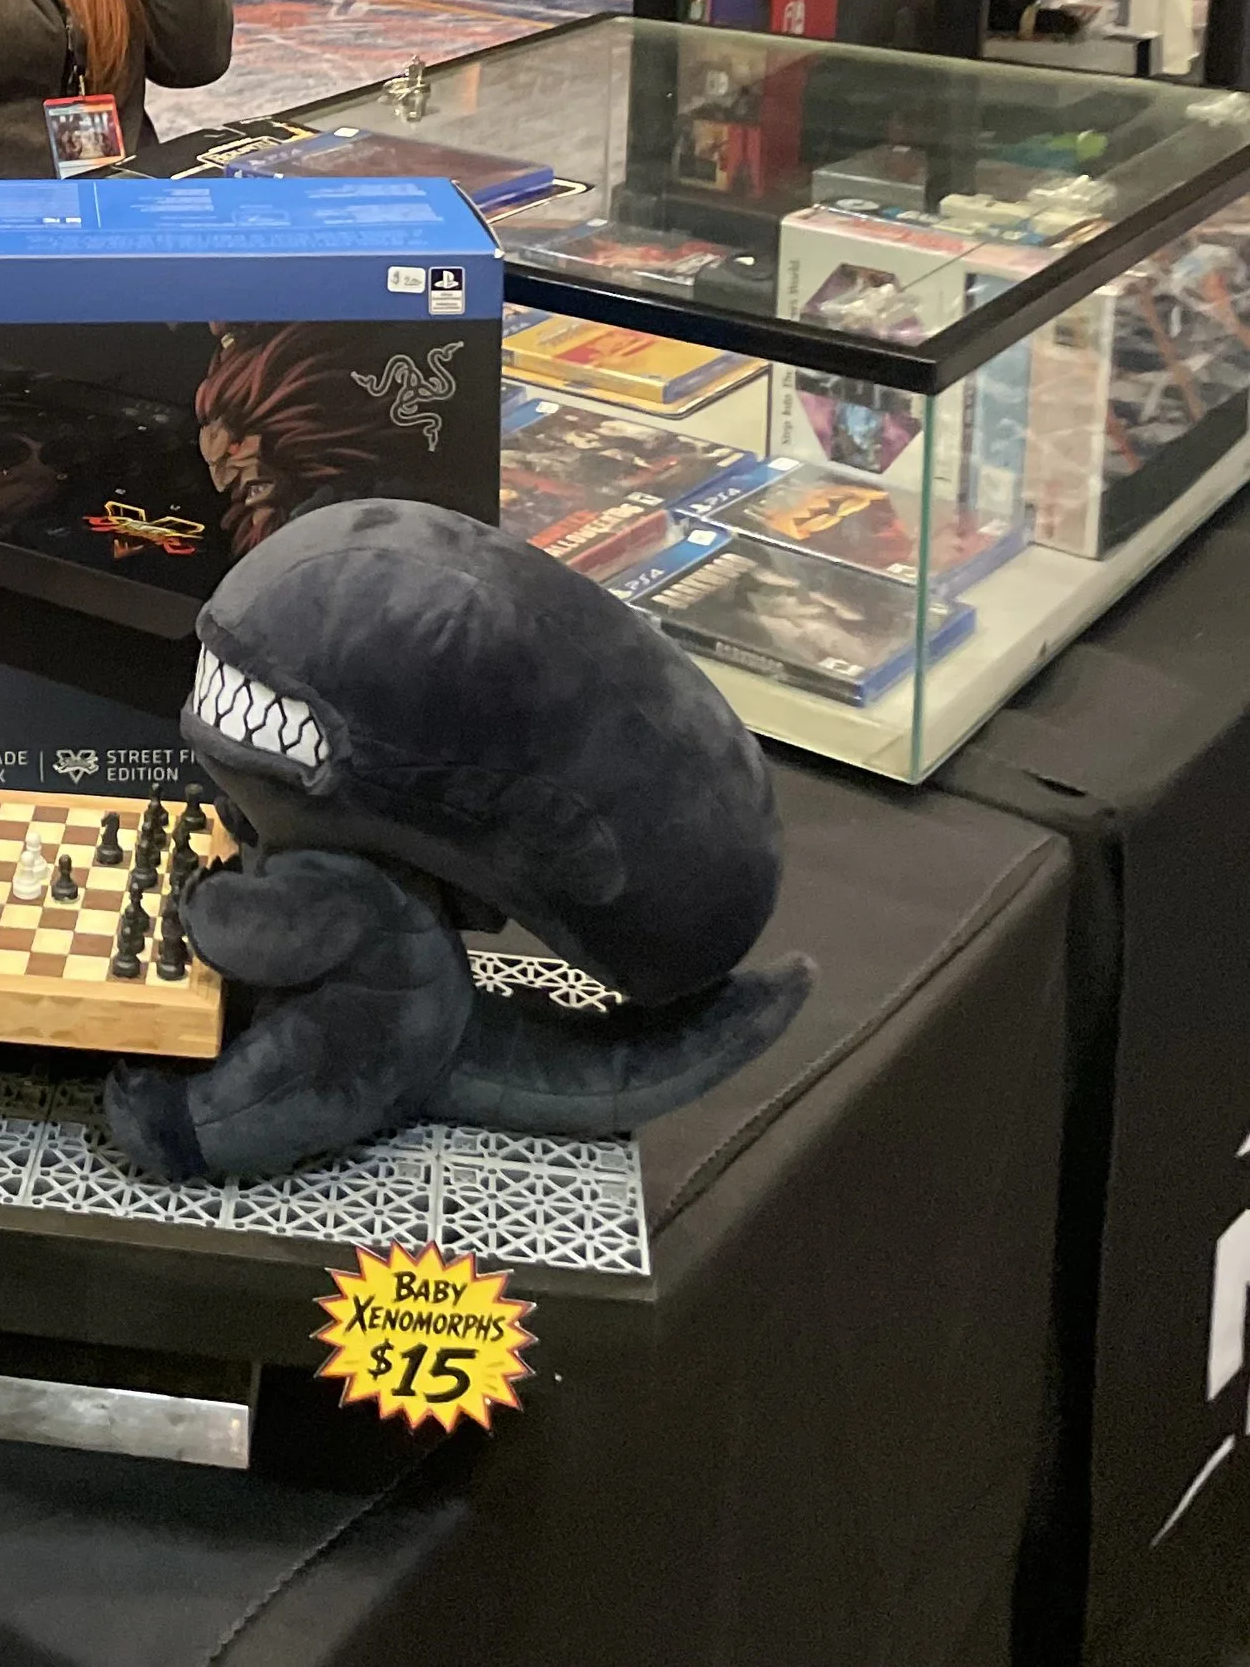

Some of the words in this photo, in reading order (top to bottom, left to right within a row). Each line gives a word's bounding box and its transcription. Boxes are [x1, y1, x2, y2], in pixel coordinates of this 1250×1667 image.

[106, 750, 176, 765] STREET
[107, 767, 179, 782] EDITION
[393, 1271, 468, 1306] BABY
[344, 1294, 506, 1342] XENOMORPHS
[367, 1338, 479, 1403] $15
